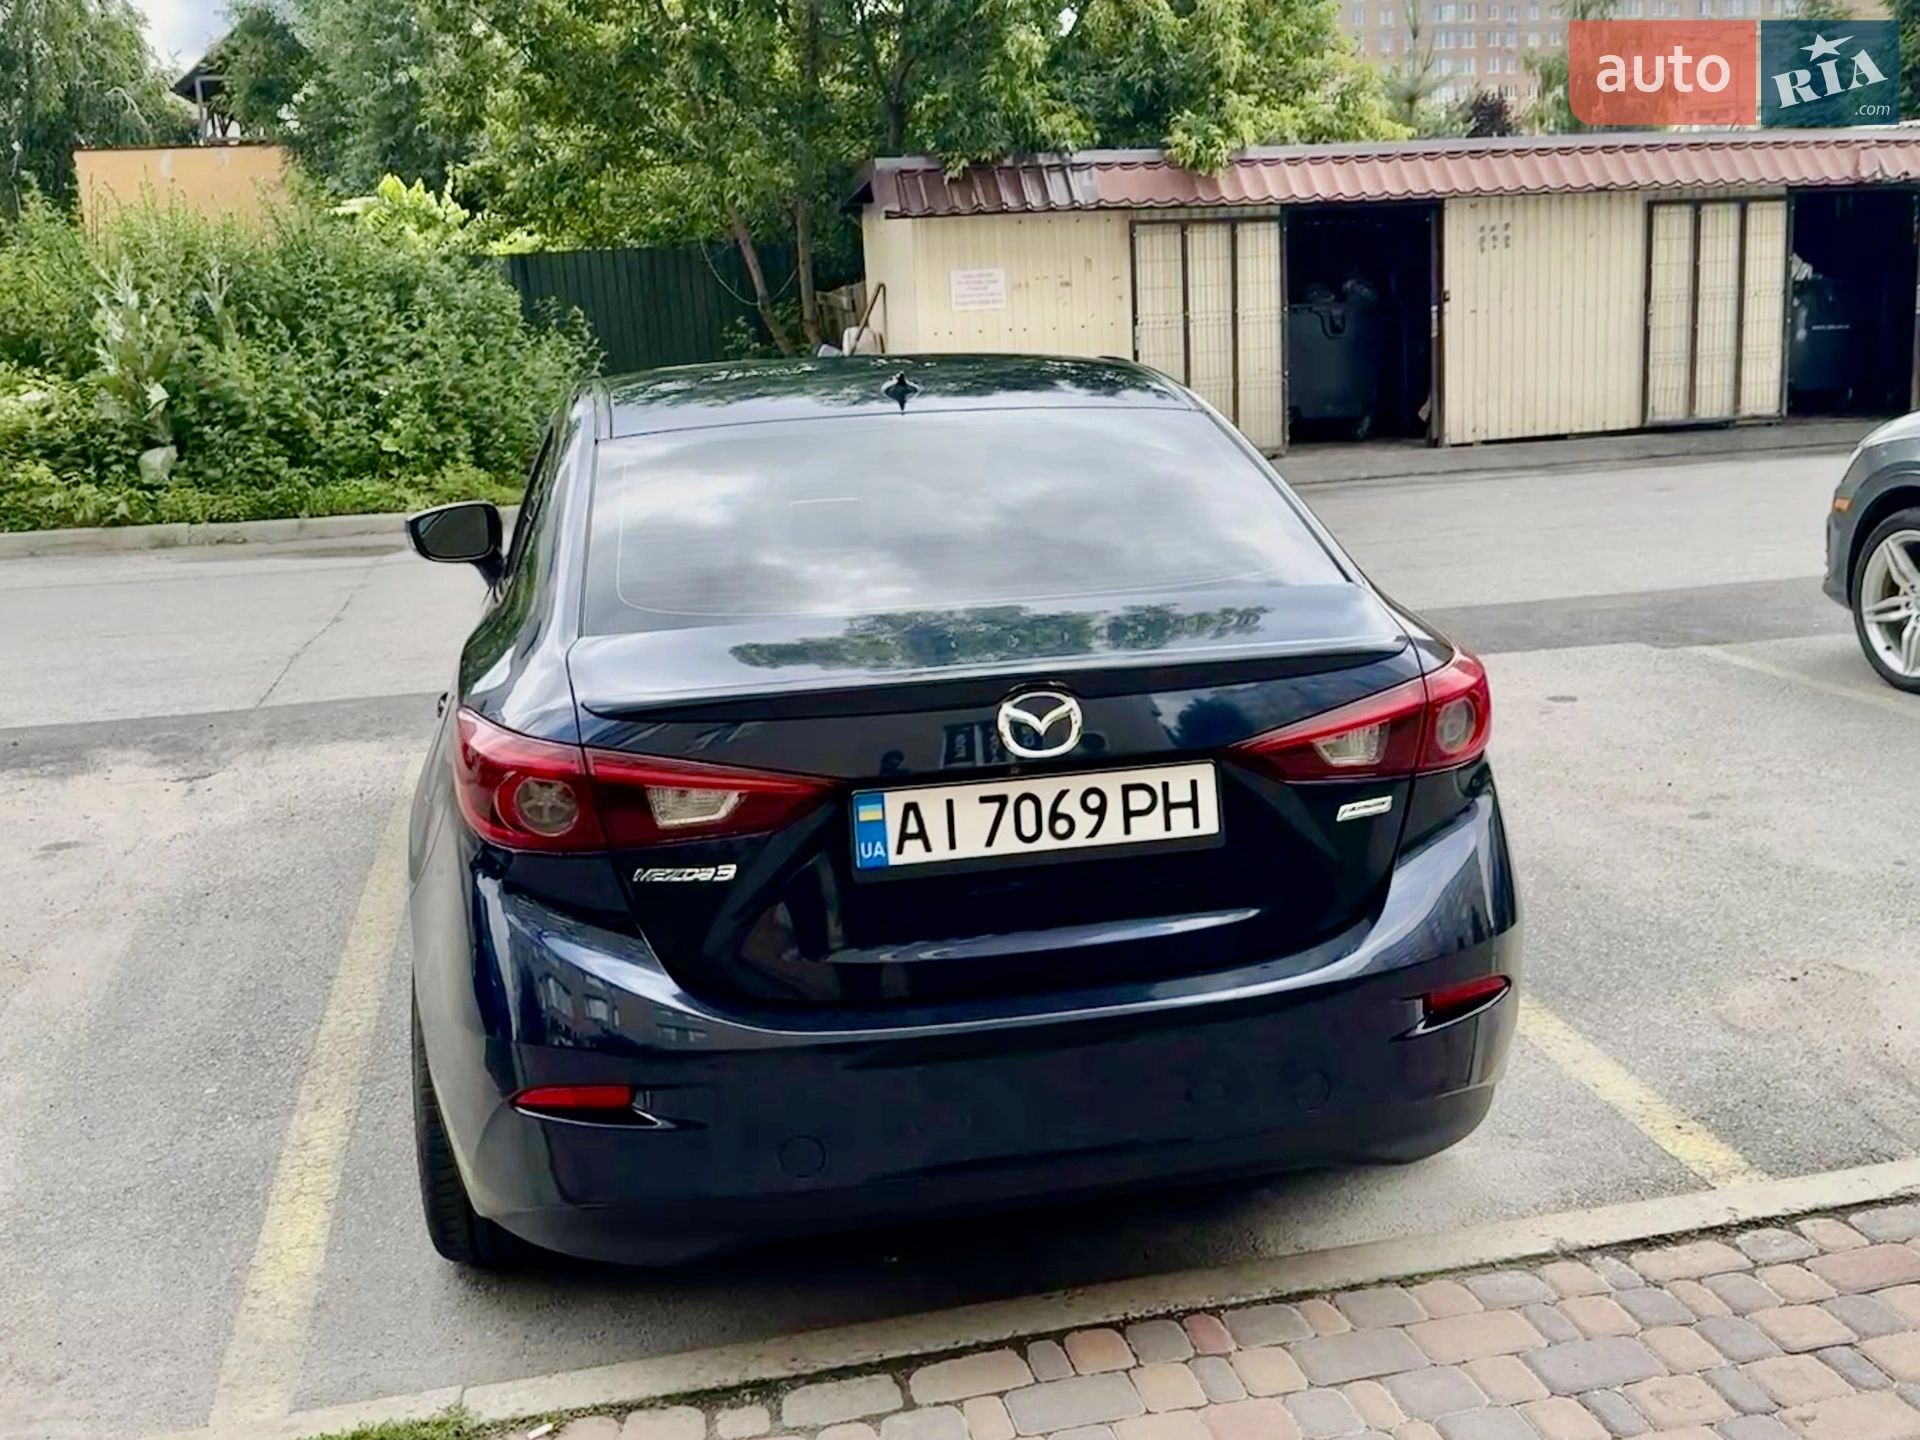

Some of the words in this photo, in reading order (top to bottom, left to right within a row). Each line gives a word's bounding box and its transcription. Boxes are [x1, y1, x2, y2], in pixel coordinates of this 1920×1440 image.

[895, 798, 957, 856] AI
[978, 787, 1109, 848] 7069
[1121, 779, 1201, 836] PH
[860, 841, 887, 859] UA
